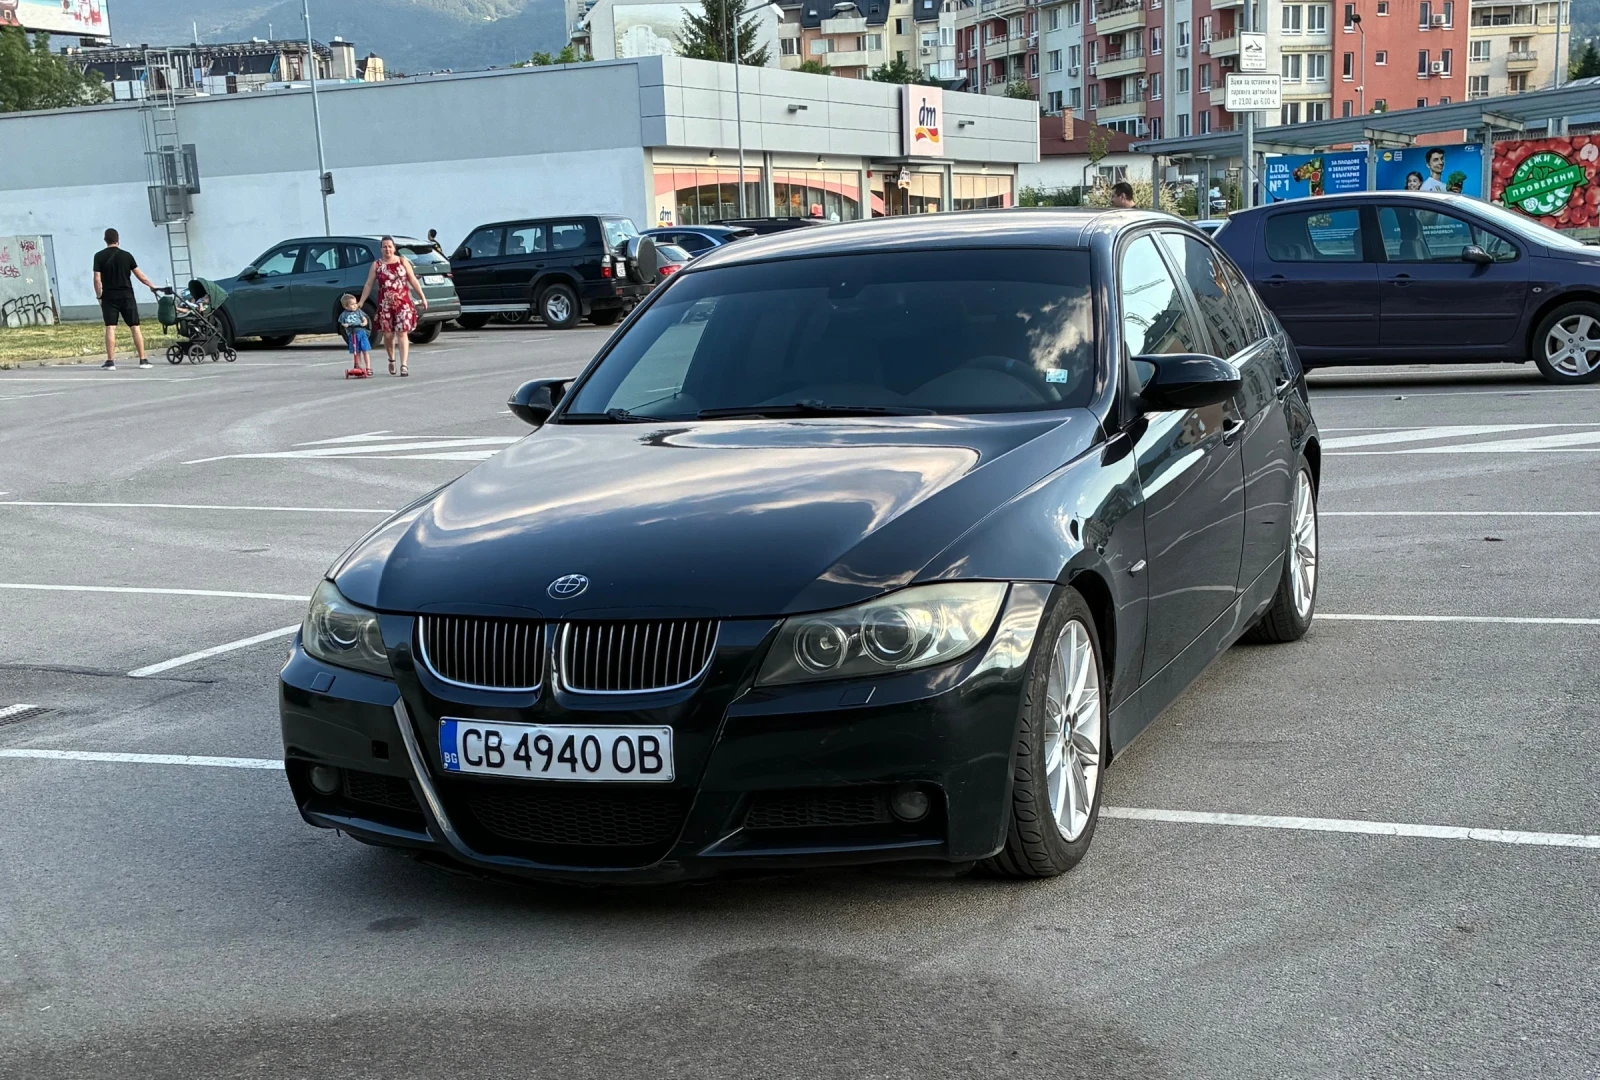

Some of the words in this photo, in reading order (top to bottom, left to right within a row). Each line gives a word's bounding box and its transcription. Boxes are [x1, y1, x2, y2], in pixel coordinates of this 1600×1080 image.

[918, 98, 936, 127] dm
[1270, 164, 1290, 173] LIDL
[1517, 154, 1550, 177] СВЕЖИ
[1554, 157, 1562, 165] И
[1512, 171, 1574, 196] ПРОВЕРЕНИ
[660, 206, 671, 221] dm
[444, 752, 458, 764] BG
[462, 728, 504, 768] CB
[514, 733, 601, 772] 4940
[612, 735, 663, 774] OB
